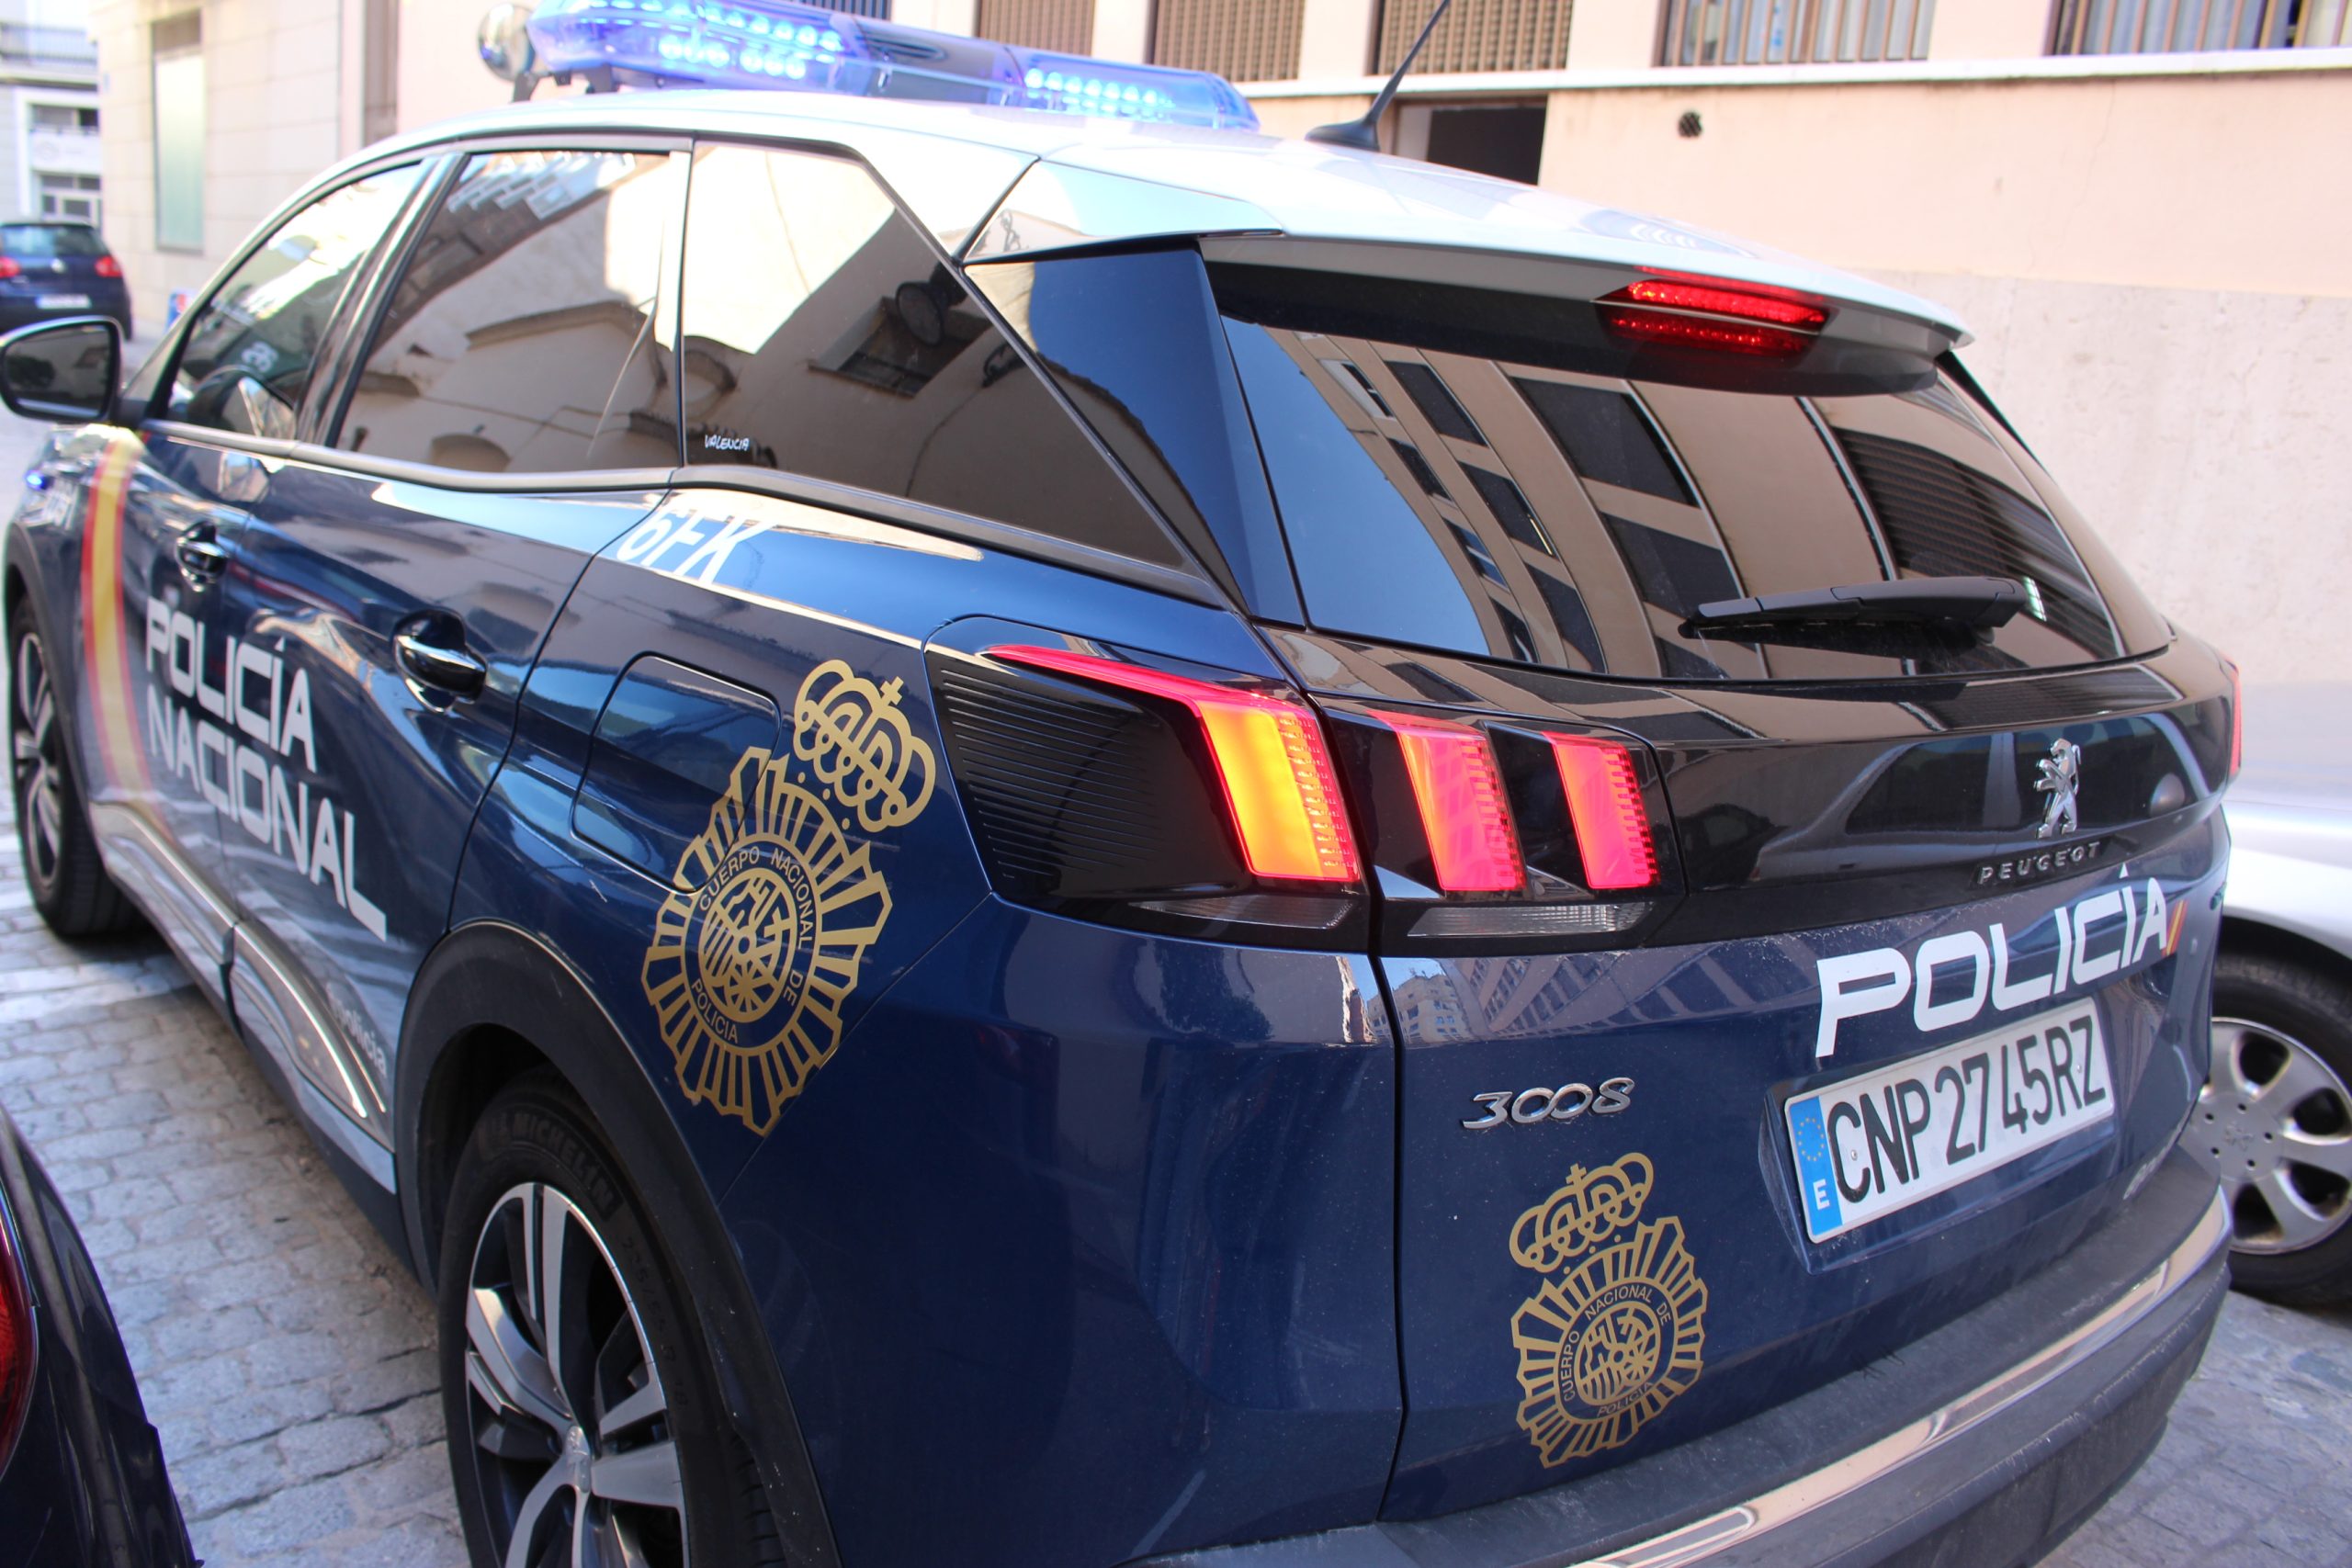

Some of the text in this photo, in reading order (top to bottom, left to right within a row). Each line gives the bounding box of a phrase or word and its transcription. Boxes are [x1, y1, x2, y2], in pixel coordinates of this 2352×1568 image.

[705, 434, 750, 451] VALENCIA
[148, 682, 386, 942] NACIONAL
[1978, 841, 2101, 886] PEUGEOT
[691, 846, 813, 1044] CUERPO NACIONAL DE POLICIA
[1462, 1077, 1635, 1129] 3008
[1813, 1179, 1829, 1210] E
[1561, 1284, 1671, 1417] CUERPO NACIONAL DE POLICIA
